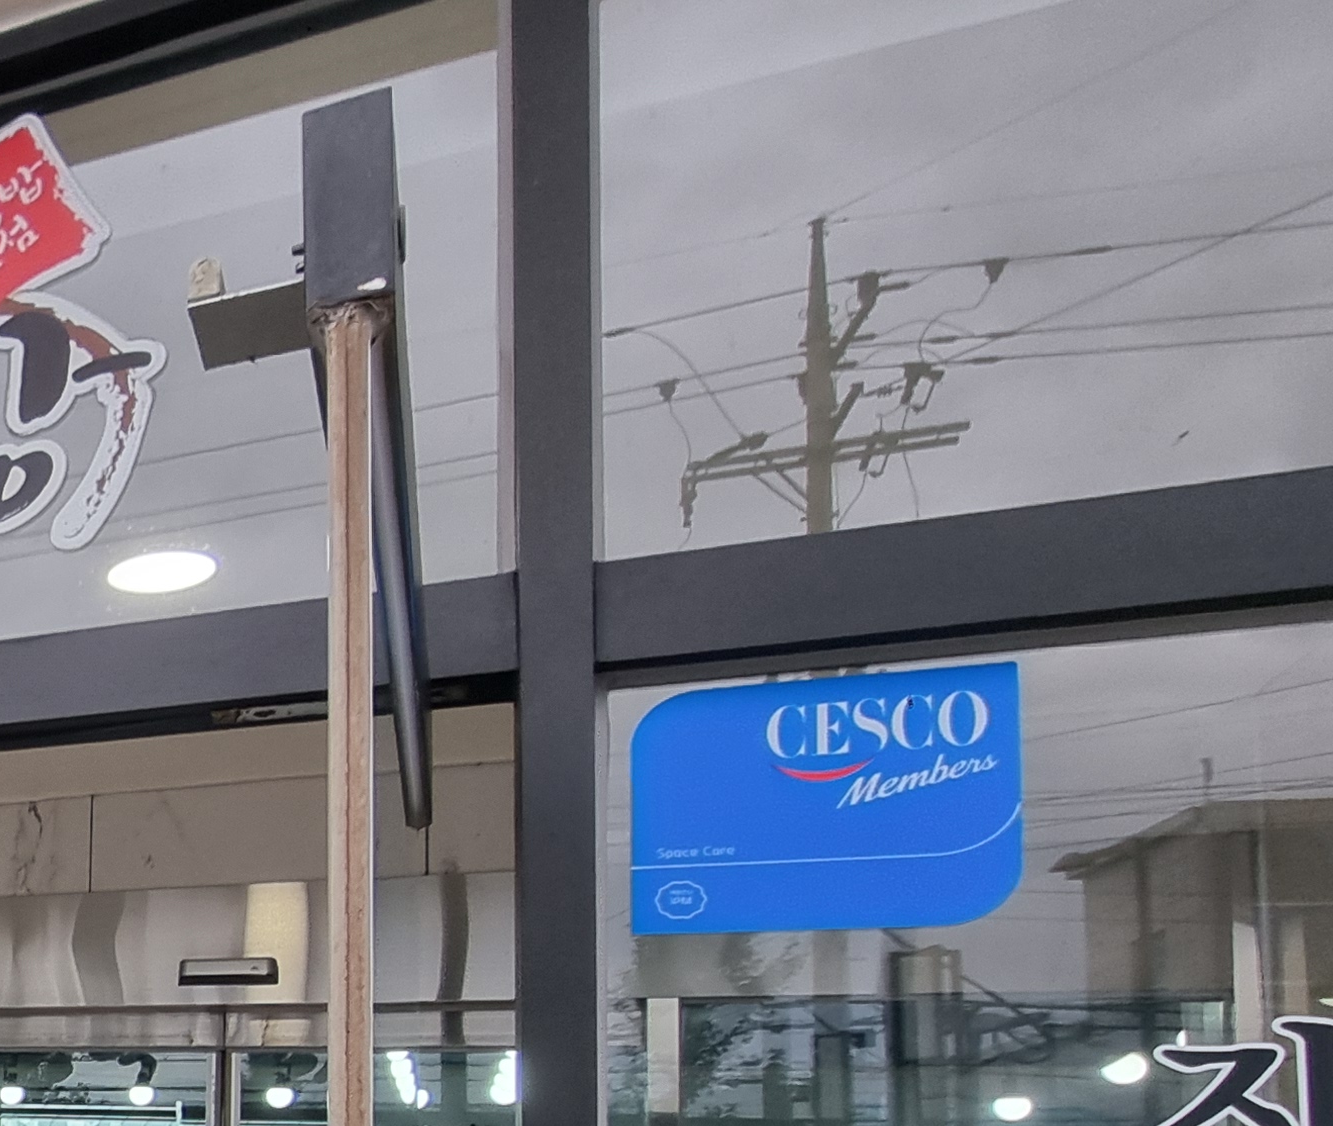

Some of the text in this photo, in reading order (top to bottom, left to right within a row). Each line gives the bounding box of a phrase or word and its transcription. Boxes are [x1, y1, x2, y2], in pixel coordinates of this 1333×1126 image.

[765, 689, 991, 760] CESCO
[836, 751, 1000, 810] Members
[656, 846, 735, 859] Space Care
